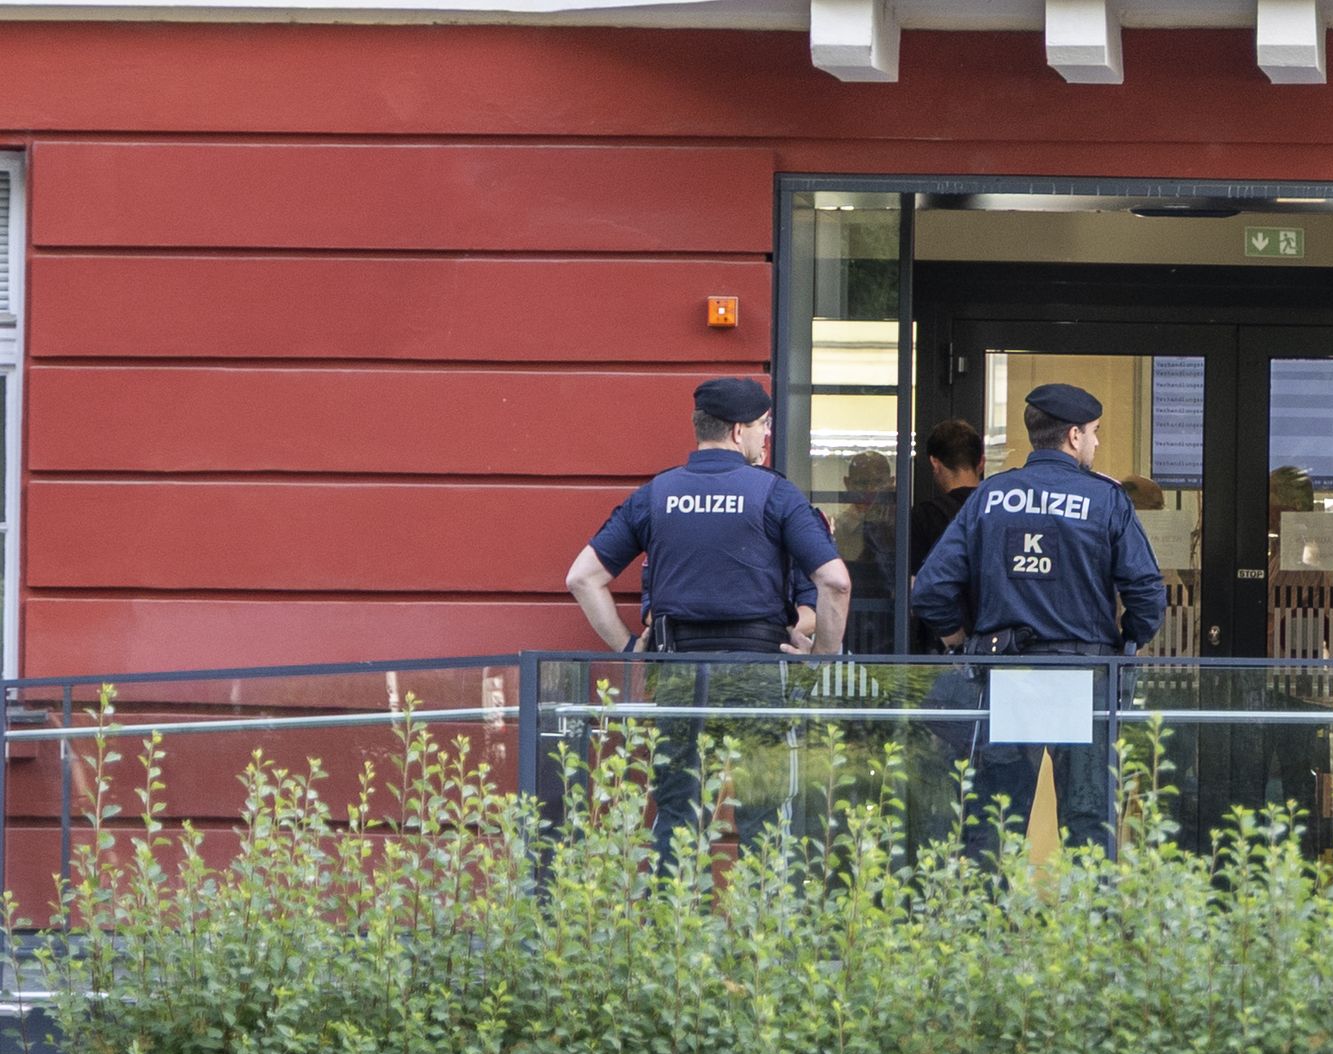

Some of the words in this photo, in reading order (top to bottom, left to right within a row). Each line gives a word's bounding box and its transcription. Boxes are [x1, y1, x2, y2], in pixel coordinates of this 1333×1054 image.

[666, 495, 744, 513] POLIZEI
[985, 488, 1091, 520] POLIZEI
[1023, 533, 1044, 553] K
[1013, 555, 1052, 573] 220
[1239, 570, 1263, 578] STOP
